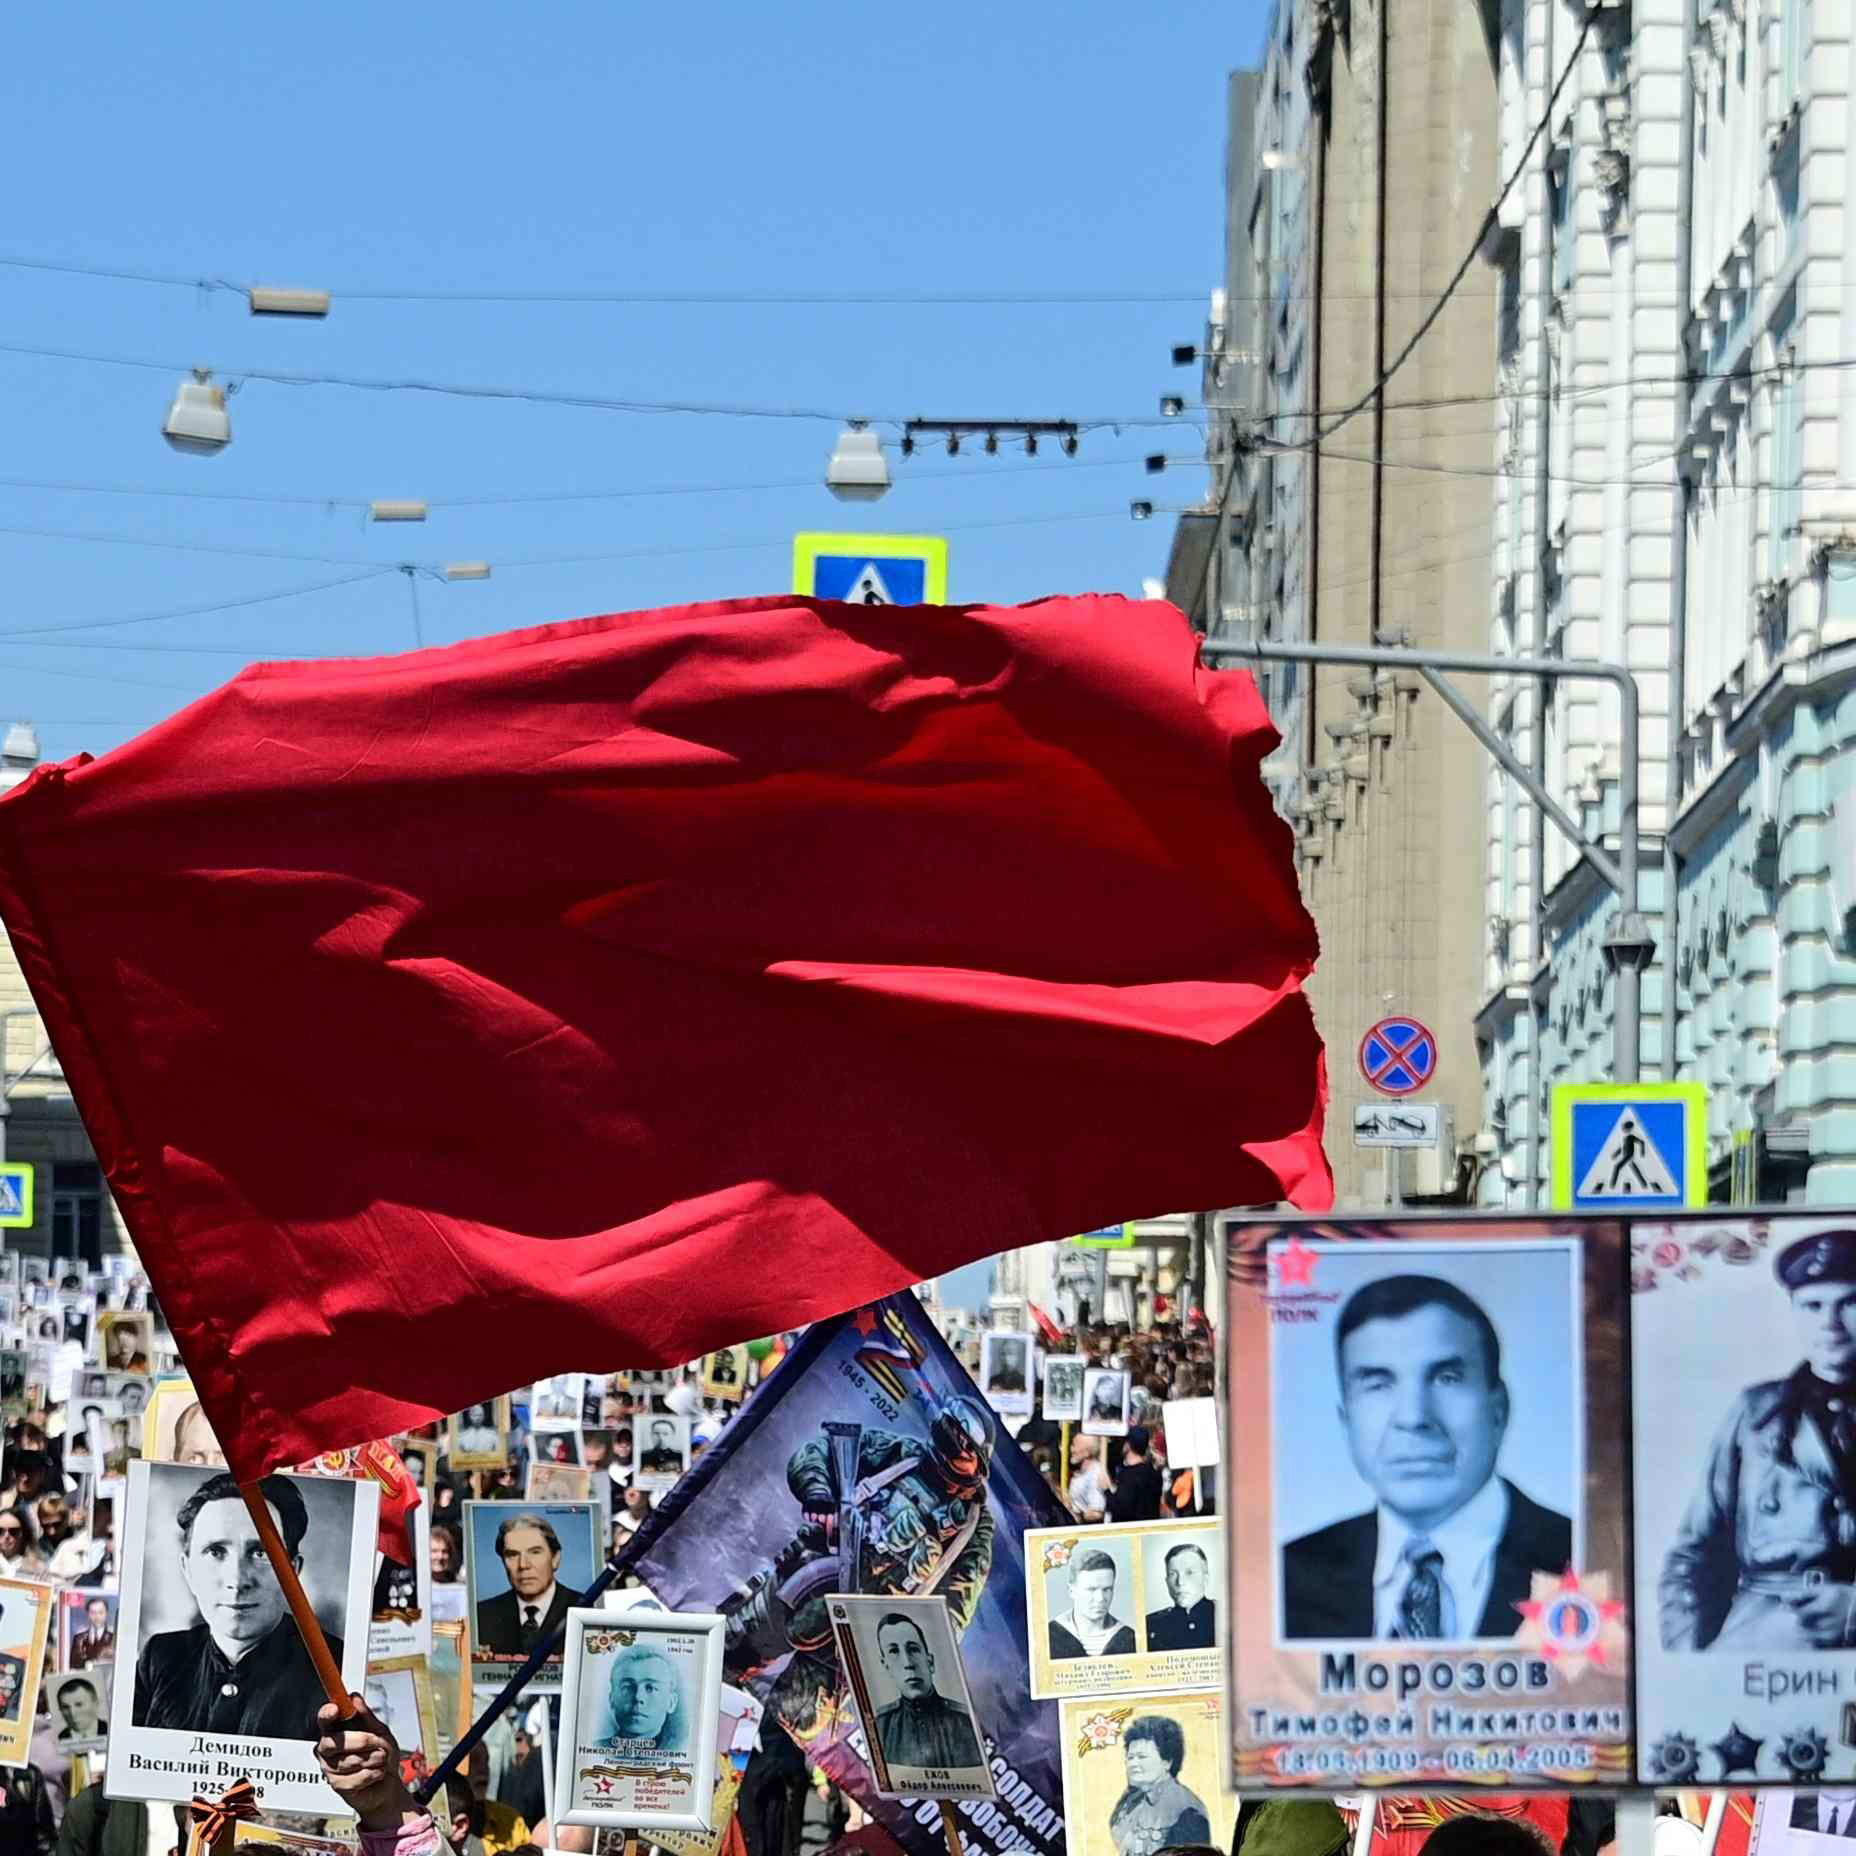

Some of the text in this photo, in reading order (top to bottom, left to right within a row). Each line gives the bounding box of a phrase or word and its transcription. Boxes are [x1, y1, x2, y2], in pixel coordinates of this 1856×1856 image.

[837, 1360, 899, 1422] 1945 2022
[1322, 1653, 1550, 1700] Морозов
[1744, 1663, 1839, 1702] Ерин
[1249, 1703, 1625, 1740] Тимофей Никитович
[128, 1753, 210, 1777] Василий
[189, 1737, 273, 1759] Демидов
[578, 1745, 624, 1755] Николай
[990, 1756, 1066, 1843] СОЛДАТ
